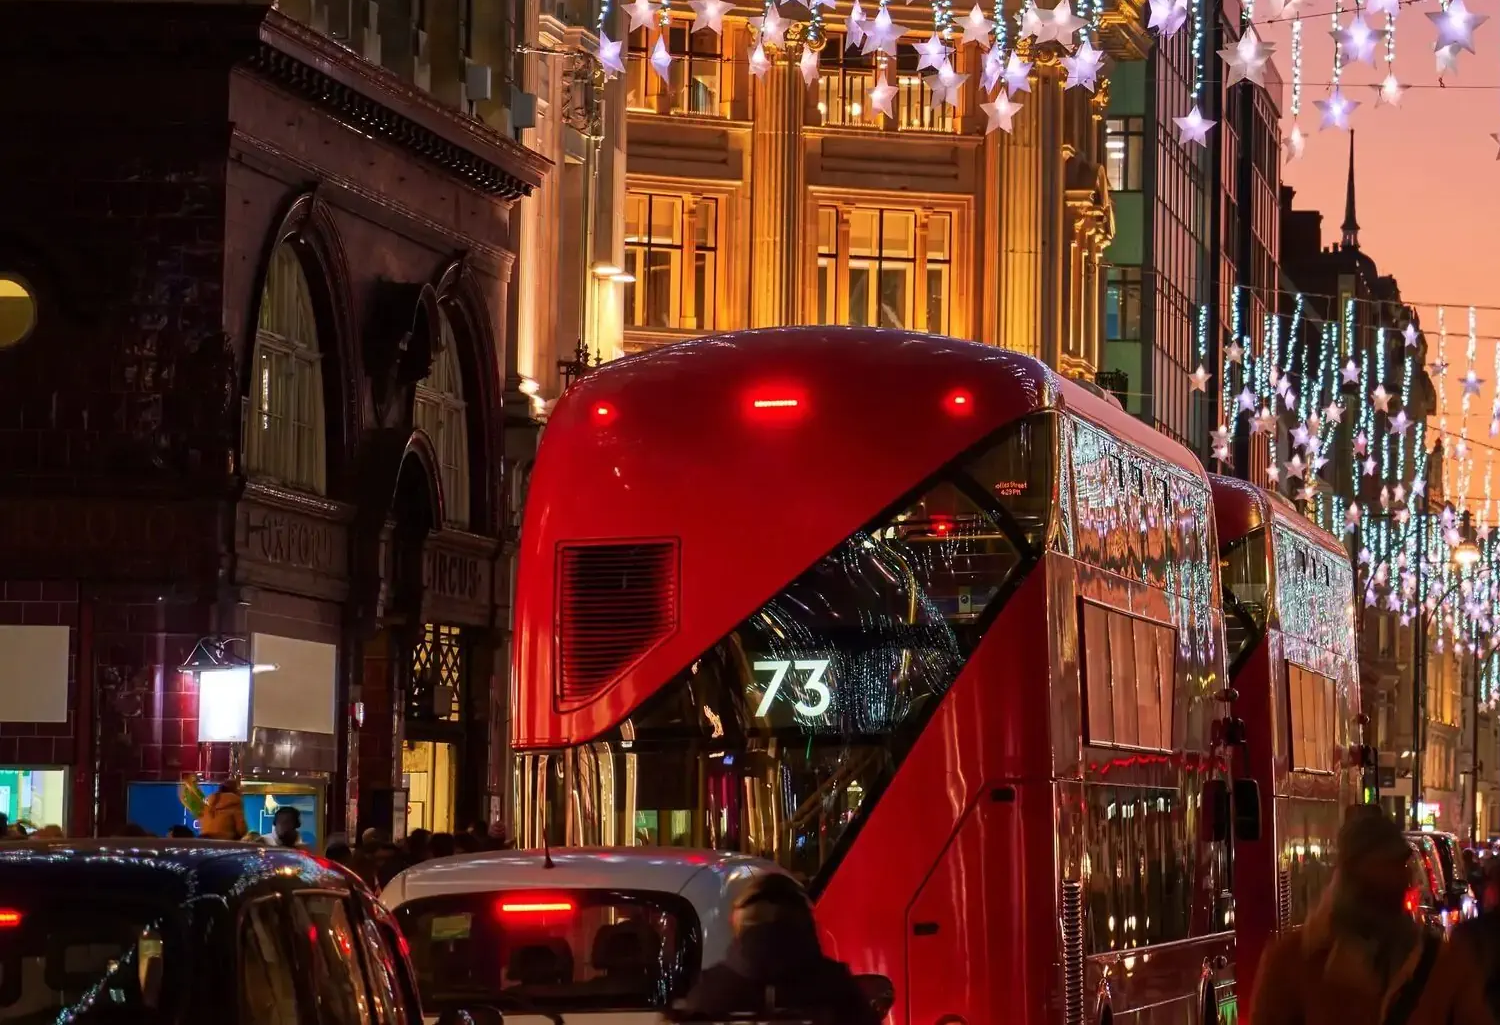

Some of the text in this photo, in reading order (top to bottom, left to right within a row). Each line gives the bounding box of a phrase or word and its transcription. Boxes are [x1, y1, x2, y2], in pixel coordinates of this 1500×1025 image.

[995, 481, 1028, 489] olles Street
[261, 515, 333, 567] OXFORD
[424, 551, 479, 599] CIRCUS
[753, 659, 831, 717] 73
